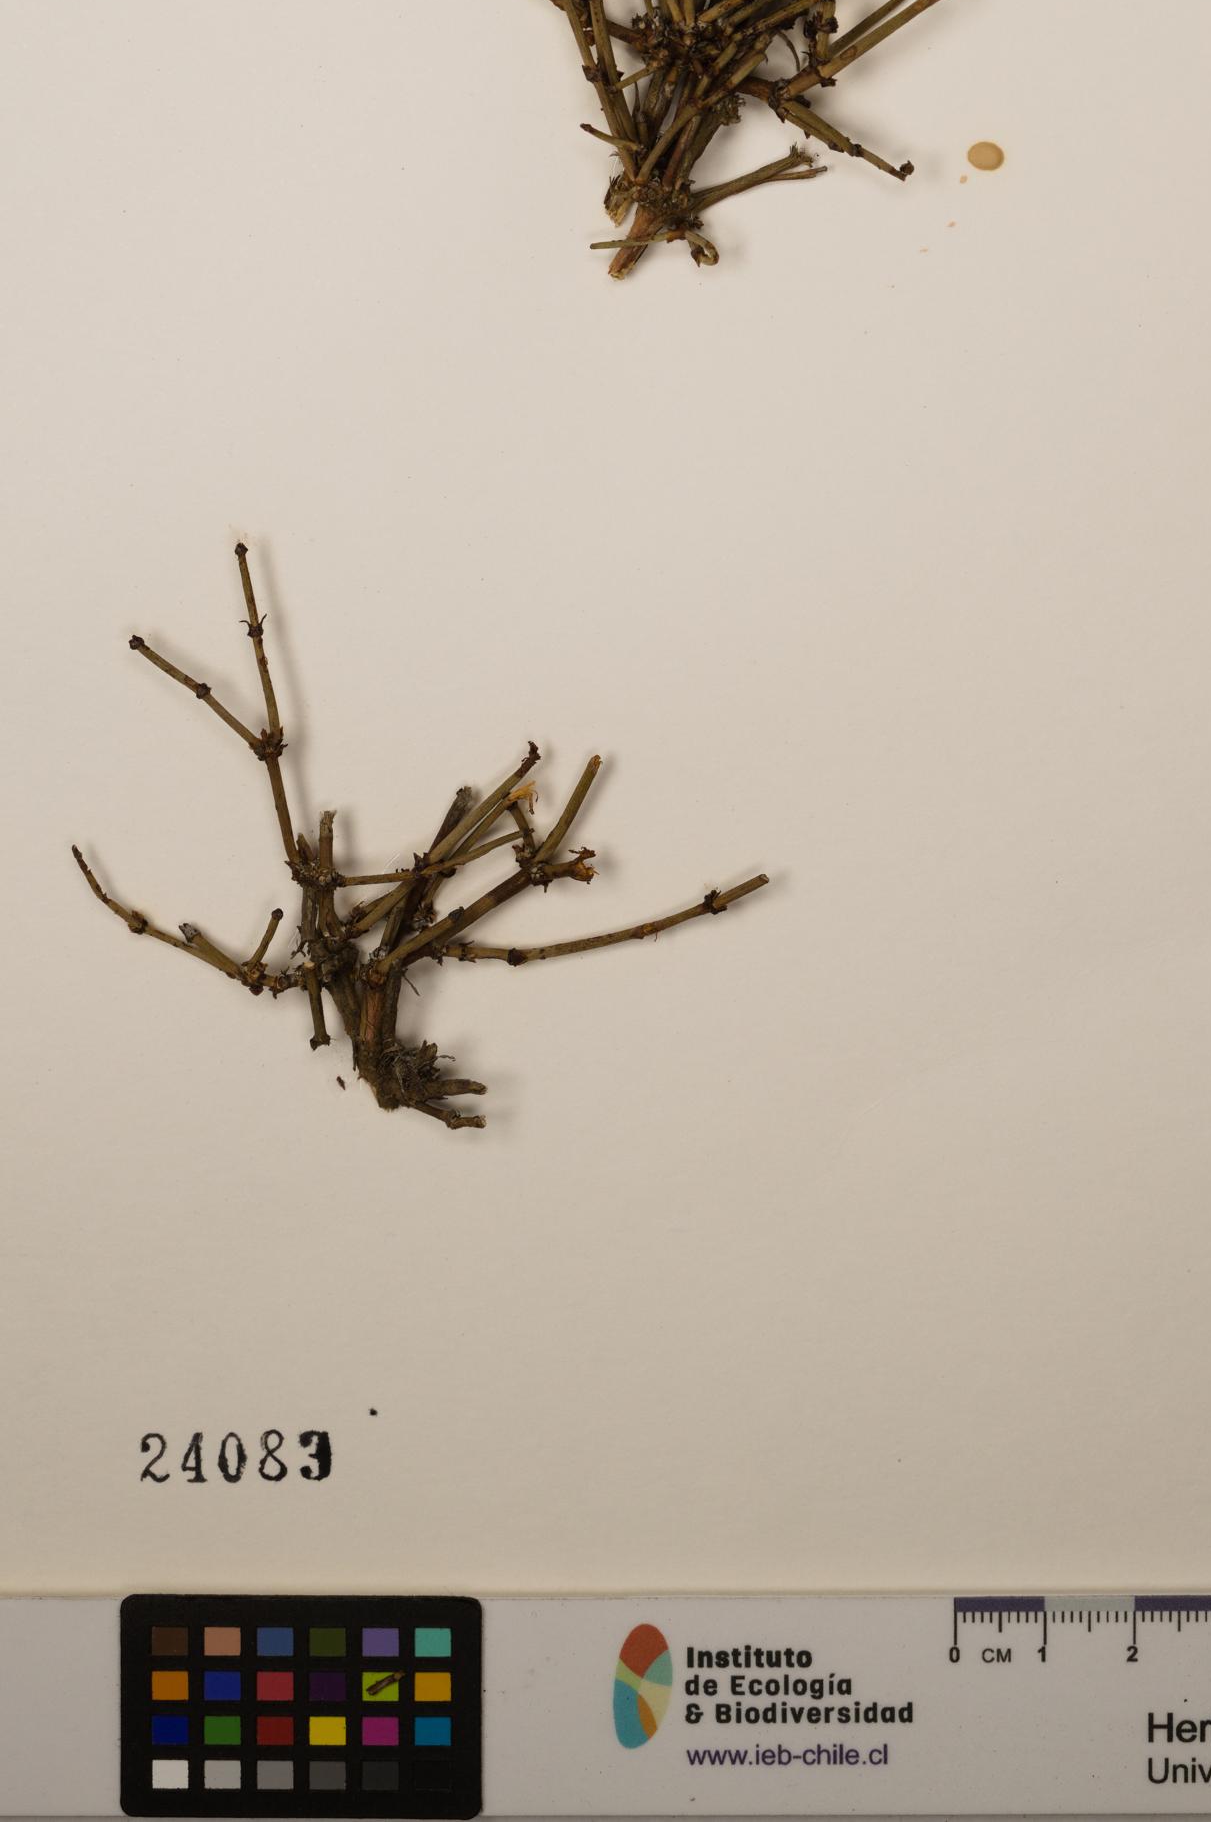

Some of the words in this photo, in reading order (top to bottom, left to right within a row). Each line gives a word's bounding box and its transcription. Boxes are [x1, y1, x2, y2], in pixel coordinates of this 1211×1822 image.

[140, 1428, 333, 1484] 24083
[686, 1644, 813, 1669] Instituto
[948, 1645, 961, 1664] 0
[981, 1647, 1012, 1664] CM
[1037, 1645, 1048, 1663] 1
[1126, 1645, 1139, 1663] 2
[684, 1674, 718, 1697] de
[730, 1672, 852, 1700] Ecología
[684, 1702, 704, 1725] &
[715, 1697, 914, 1725] Biodiversidad
[686, 1743, 889, 1766] www.ieb-chile.cl
